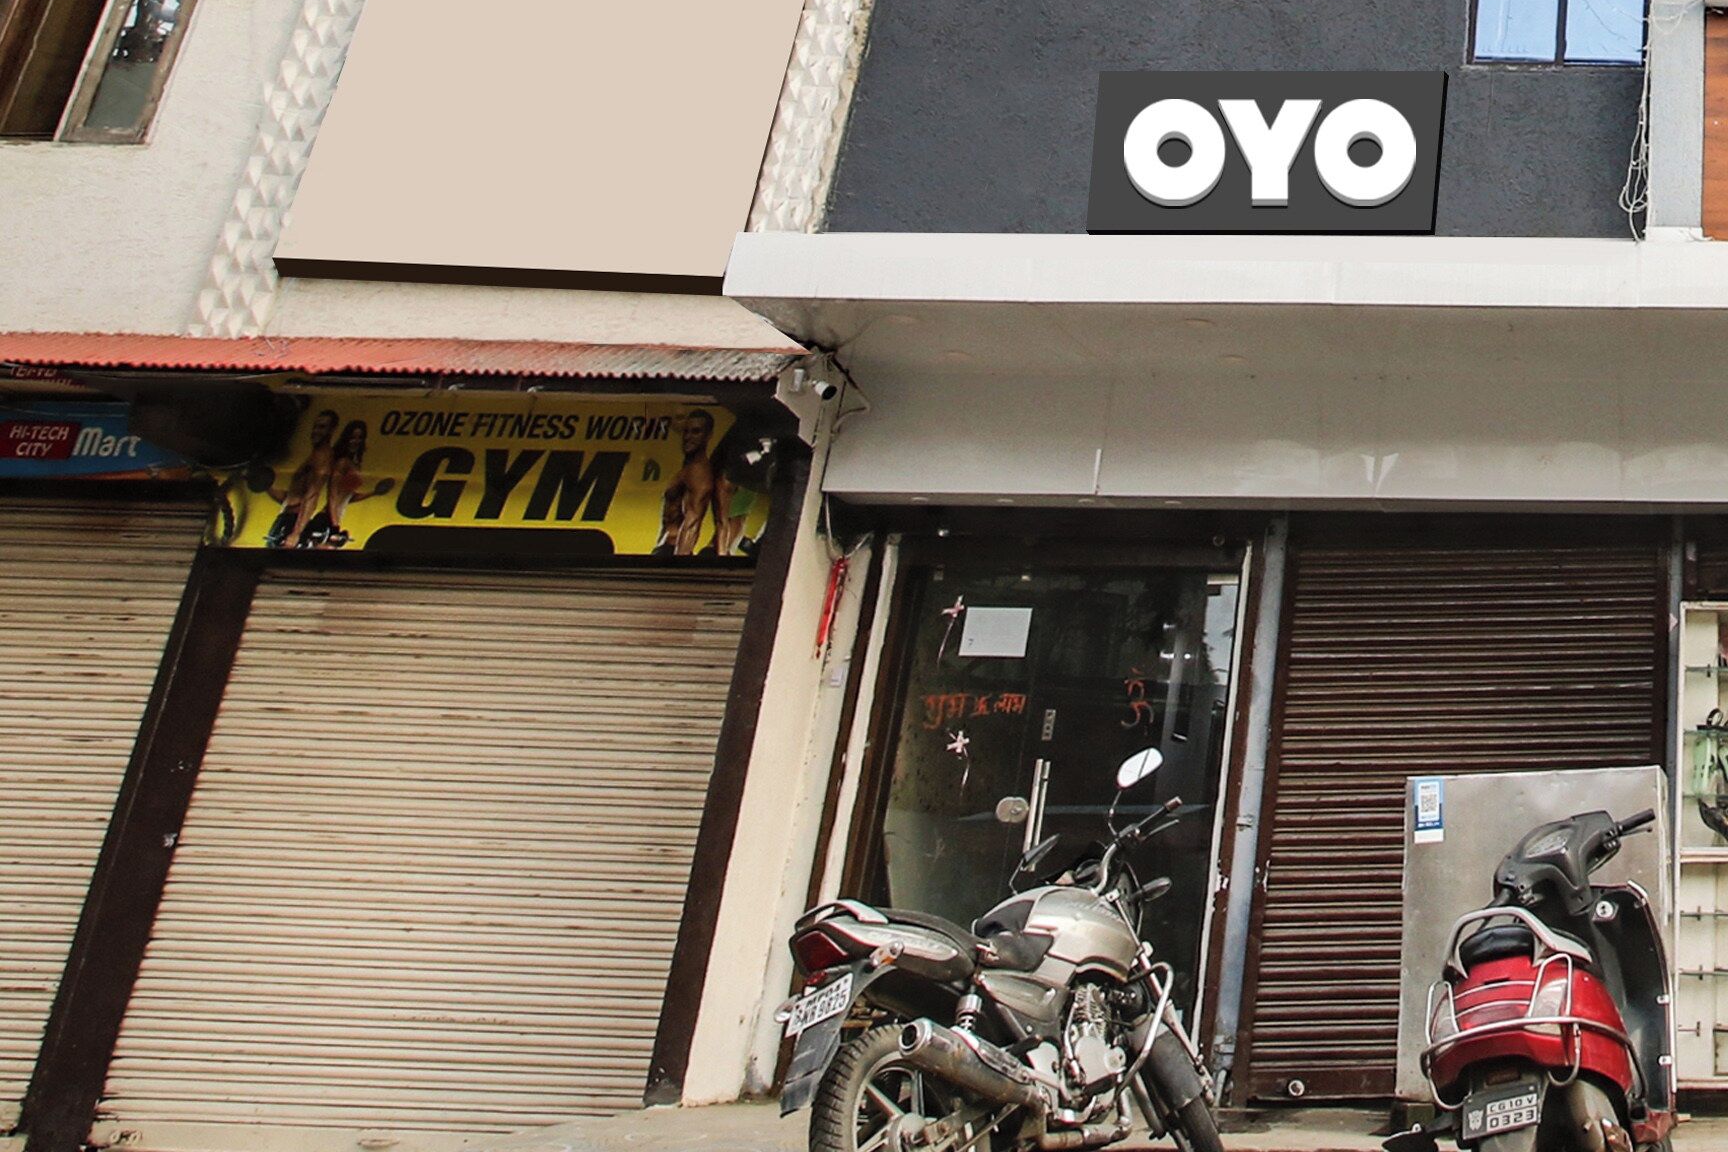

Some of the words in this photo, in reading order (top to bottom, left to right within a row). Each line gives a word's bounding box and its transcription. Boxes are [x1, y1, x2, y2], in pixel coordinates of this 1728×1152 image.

[1122, 97, 1418, 209] OYO
[9, 425, 70, 441] HI-TECH
[380, 410, 469, 437] OZONE
[470, 412, 580, 440] FITNESS
[15, 442, 54, 457] CITY
[71, 426, 142, 458] Mart
[395, 445, 632, 522] GYM
[1489, 1109, 1534, 1129] 0323
